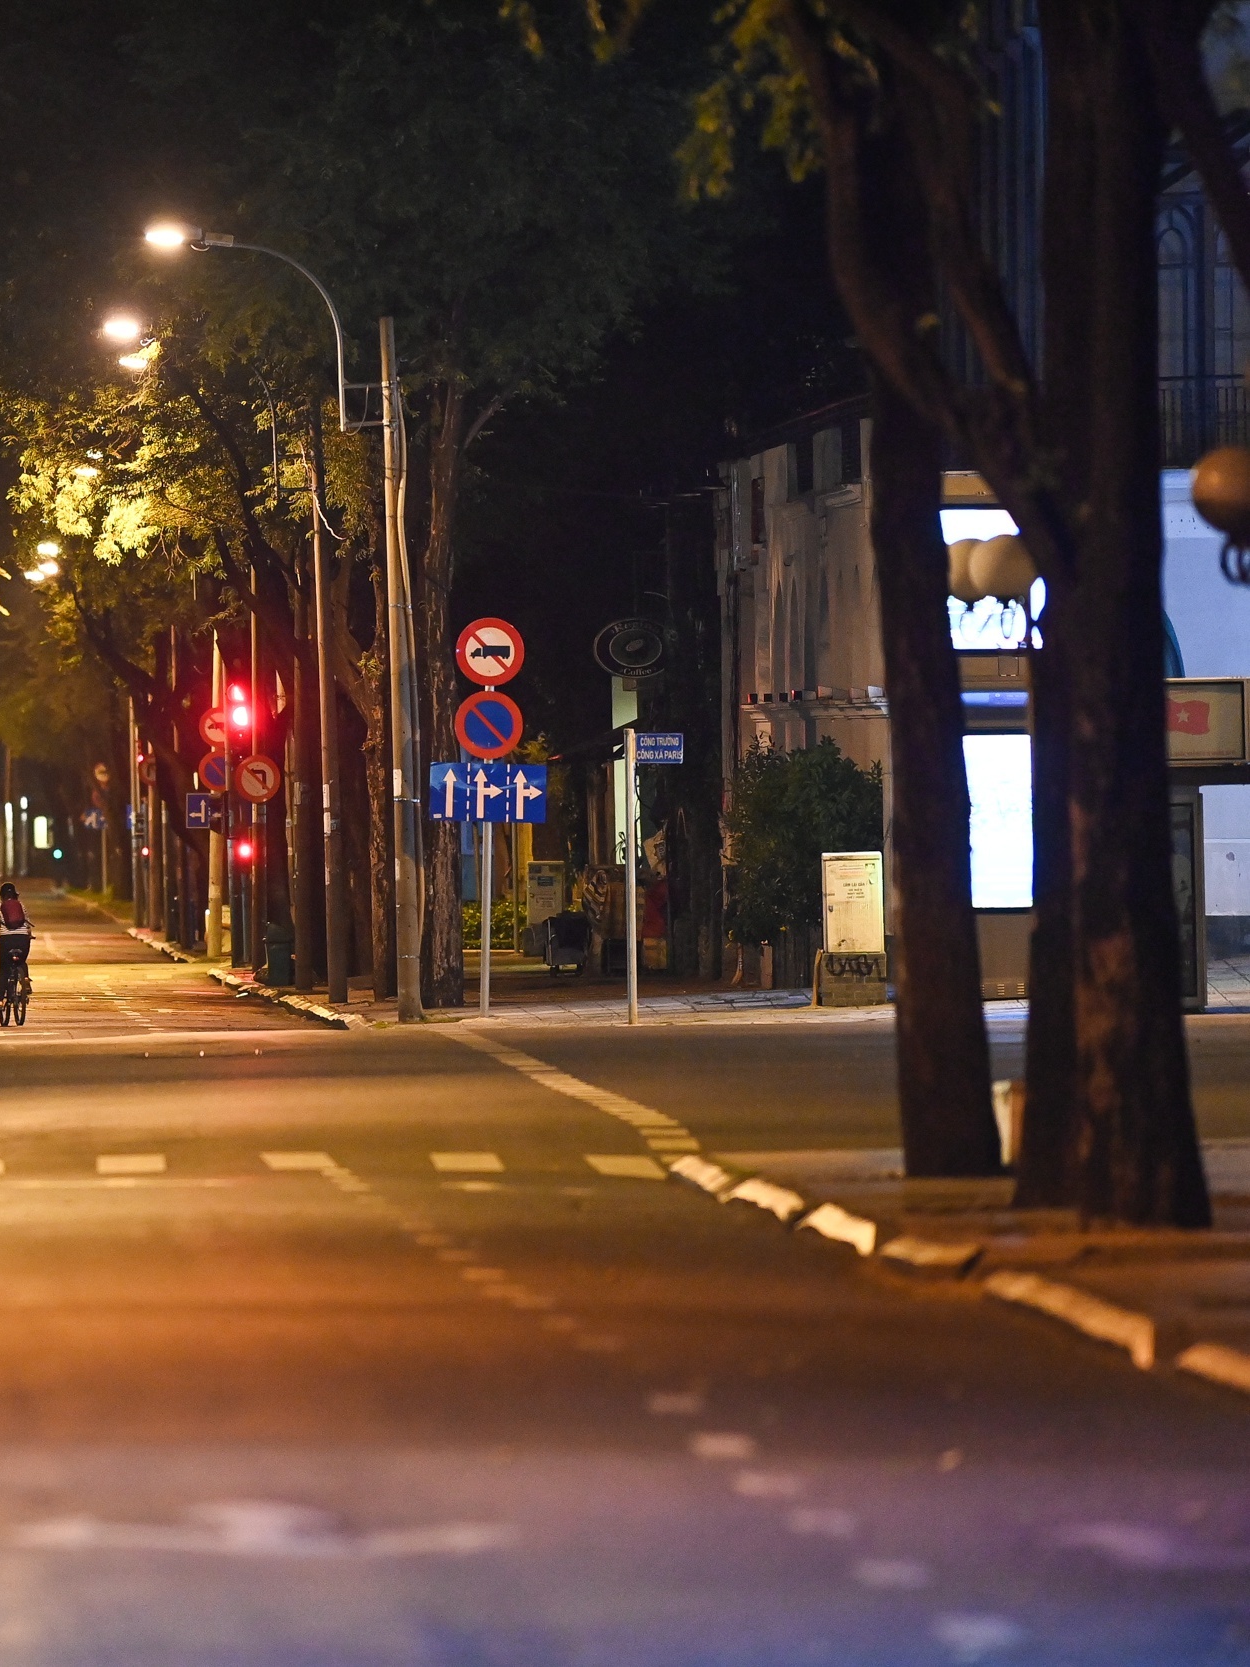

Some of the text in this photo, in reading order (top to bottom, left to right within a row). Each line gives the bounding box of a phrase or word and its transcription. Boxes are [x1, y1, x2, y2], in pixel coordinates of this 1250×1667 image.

[623, 667, 652, 676] Coffee
[640, 736, 656, 747] CÔNG
[636, 749, 654, 760] CÔNG
[664, 750, 683, 760] PARIS
